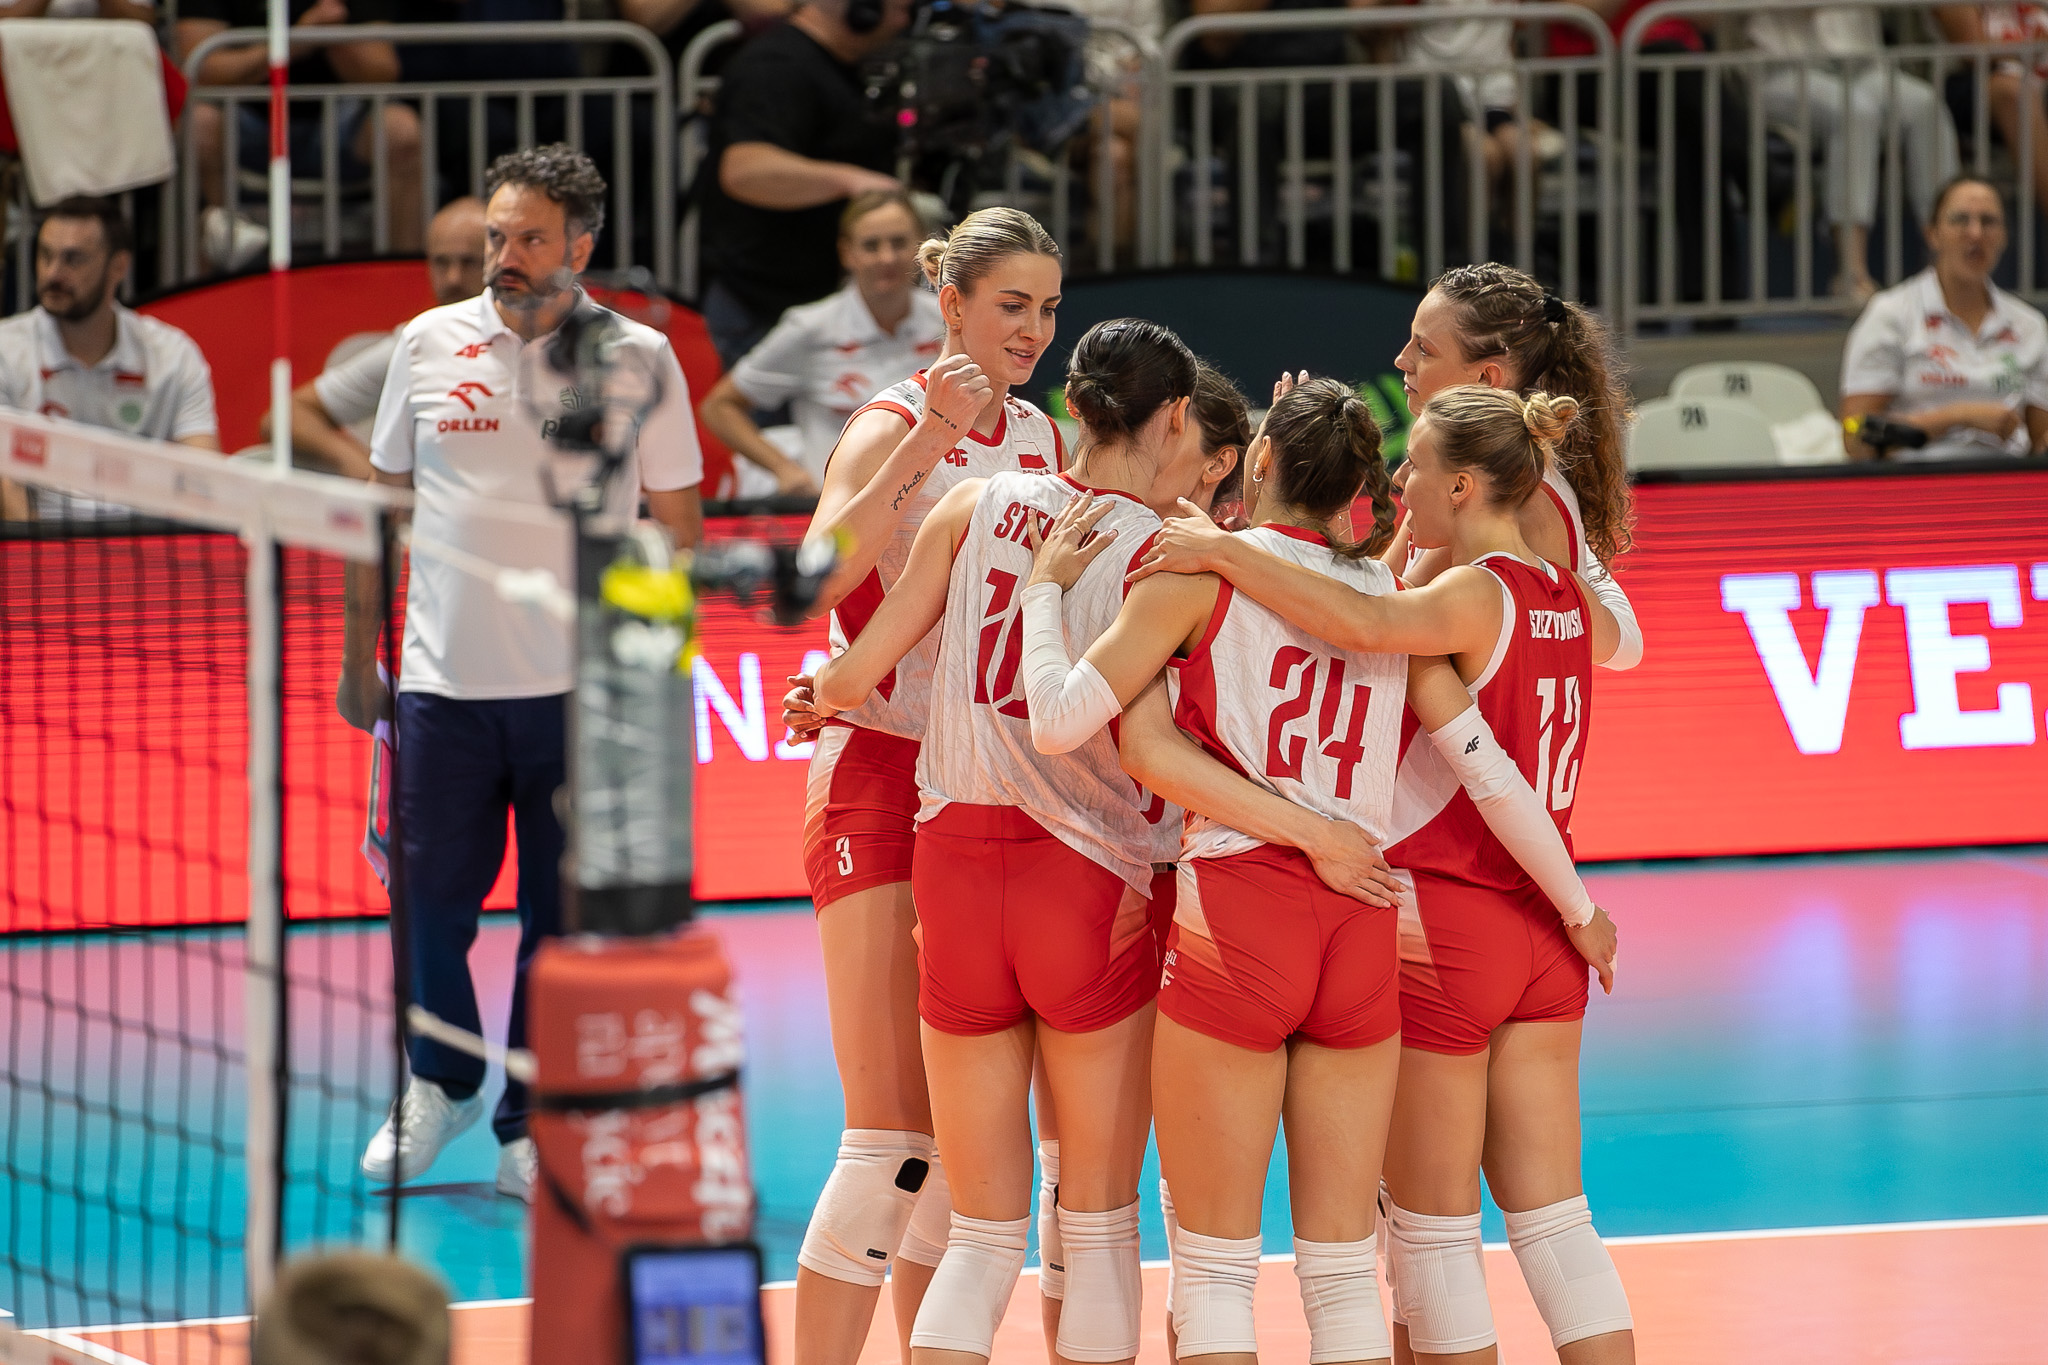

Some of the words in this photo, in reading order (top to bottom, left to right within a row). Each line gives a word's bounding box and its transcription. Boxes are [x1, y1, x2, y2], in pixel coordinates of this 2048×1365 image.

[437, 418, 499, 433] ORLEN
[1266, 645, 1372, 800] 24
[1464, 735, 1480, 755] 4F
[1536, 675, 1582, 811] 12
[835, 836, 854, 876] 3
